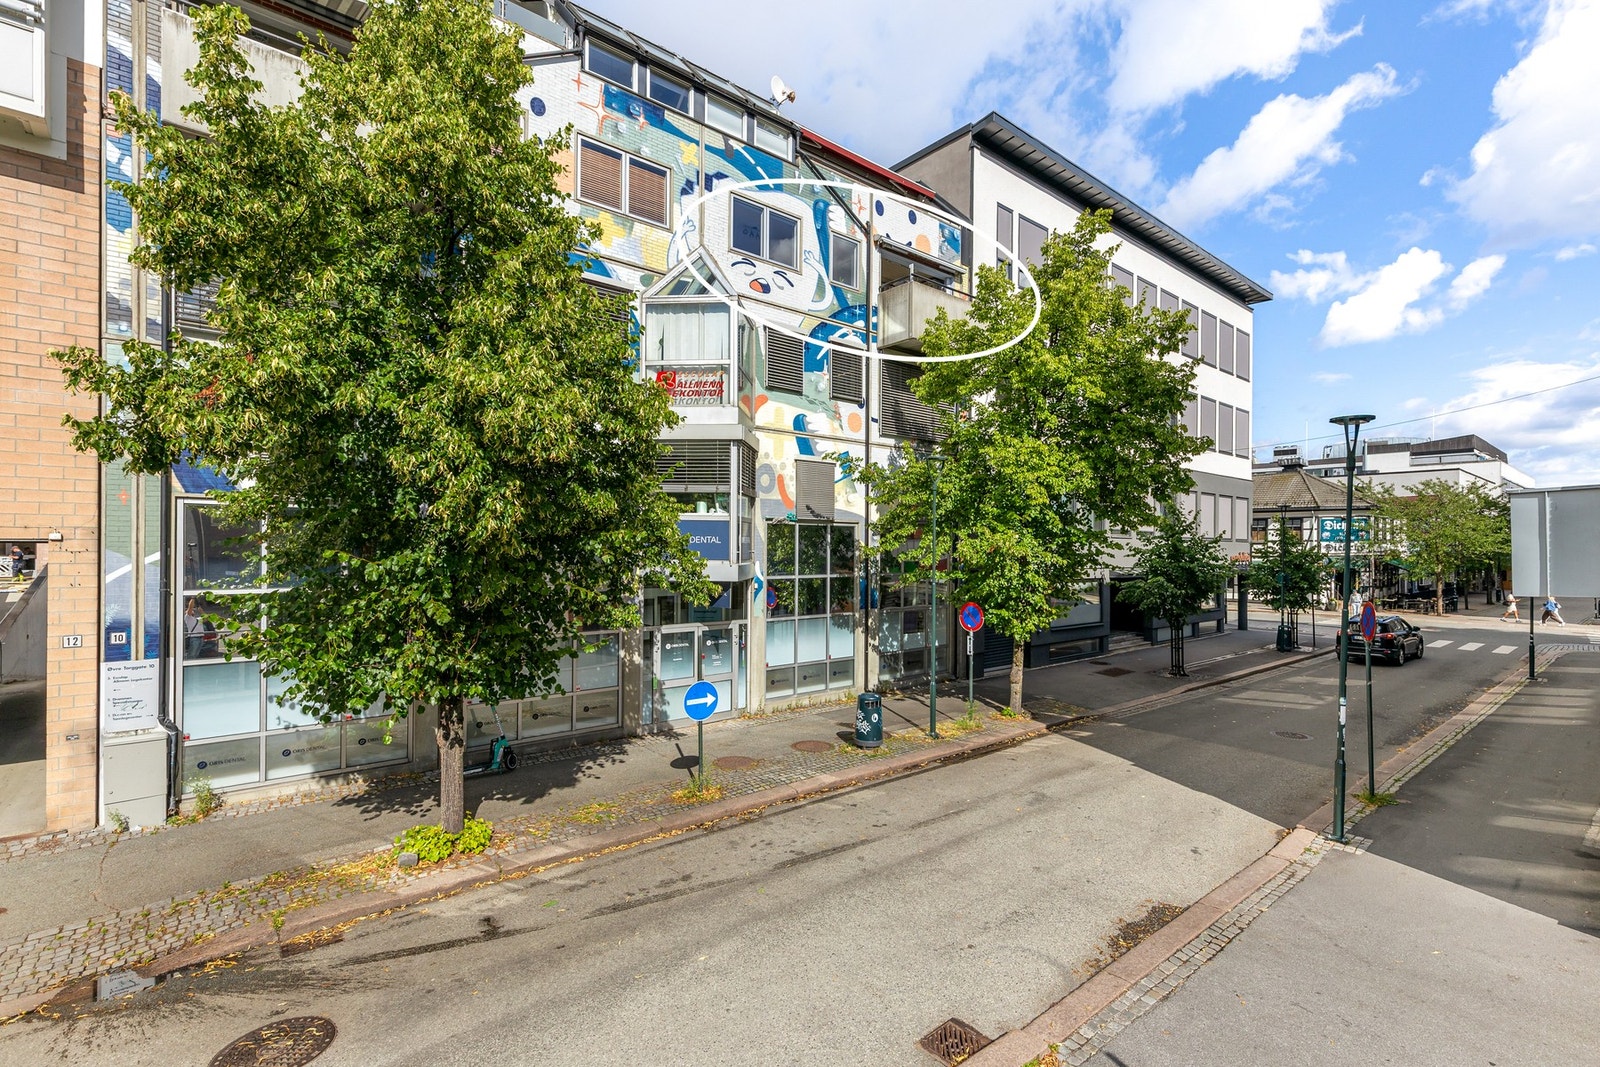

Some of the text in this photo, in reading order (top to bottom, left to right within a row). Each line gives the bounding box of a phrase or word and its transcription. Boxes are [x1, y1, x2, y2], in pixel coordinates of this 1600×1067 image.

[677, 380, 725, 389] ALLMENN
[671, 389, 725, 398] EKONTOR
[689, 535, 722, 544] DENTAL
[67, 636, 79, 646] 12
[113, 634, 124, 642] 10
